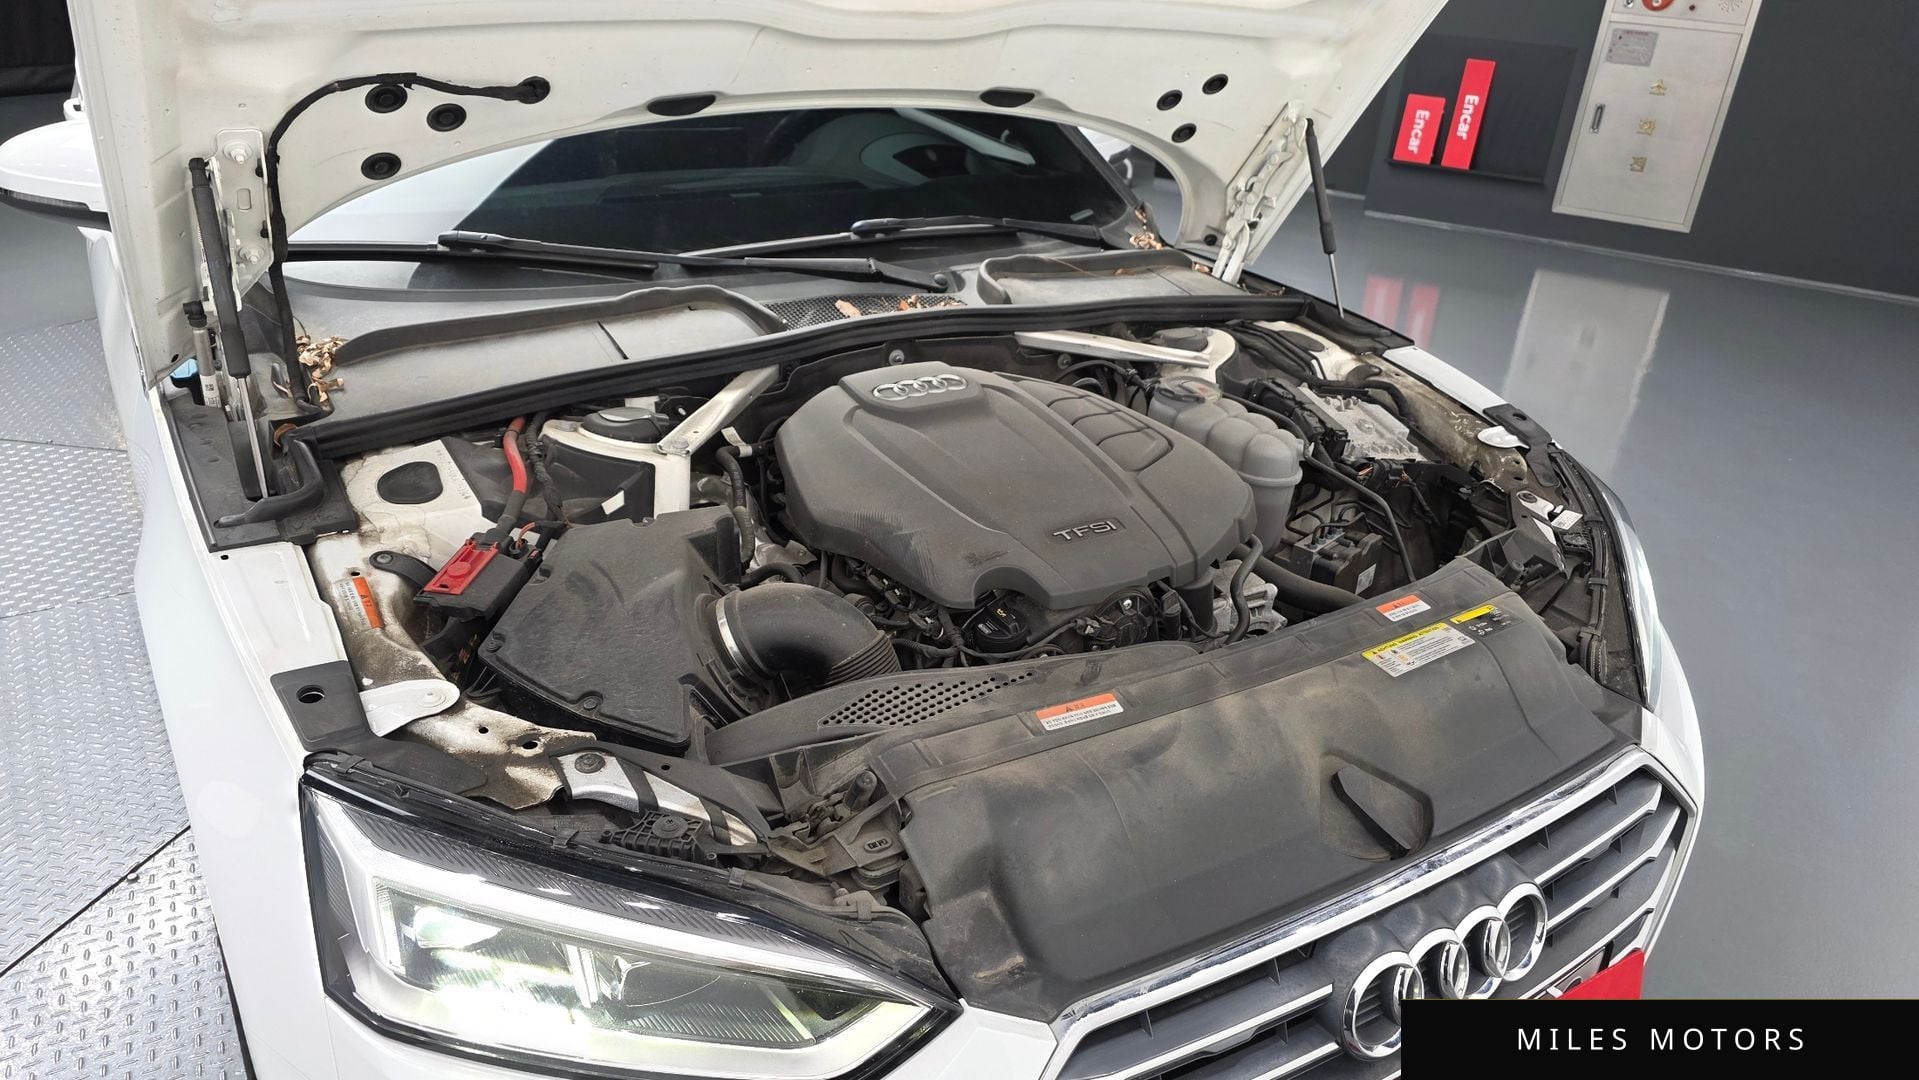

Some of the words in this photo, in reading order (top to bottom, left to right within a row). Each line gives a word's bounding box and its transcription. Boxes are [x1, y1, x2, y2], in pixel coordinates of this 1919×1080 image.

[1407, 109, 1430, 154] Encar
[1456, 94, 1479, 140] Encar
[1052, 520, 1117, 541] TFSI
